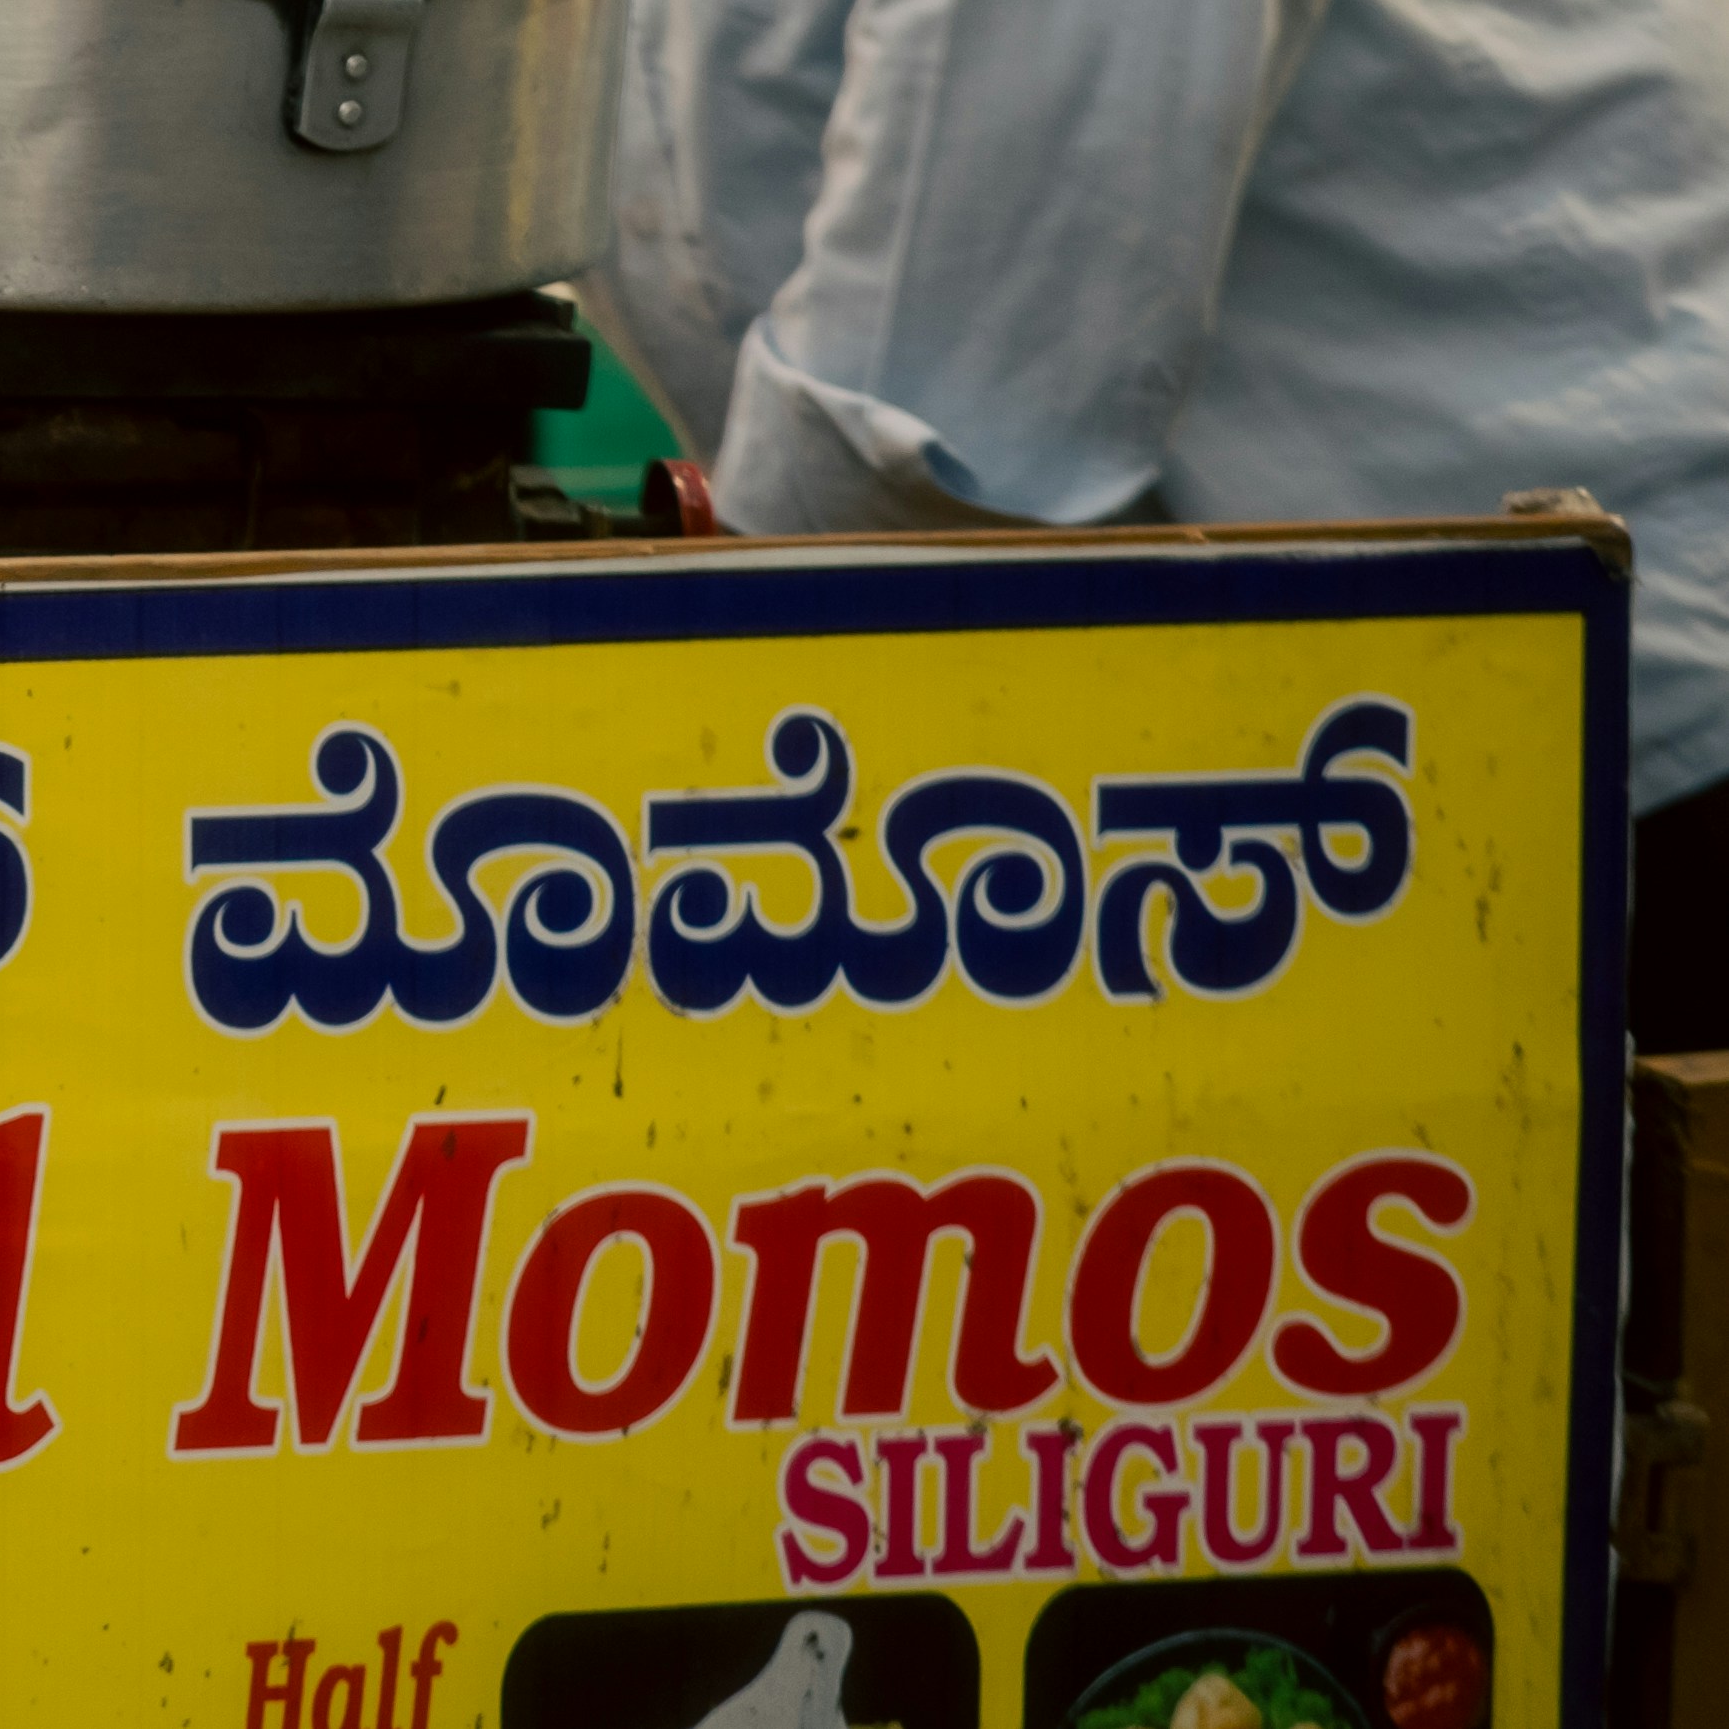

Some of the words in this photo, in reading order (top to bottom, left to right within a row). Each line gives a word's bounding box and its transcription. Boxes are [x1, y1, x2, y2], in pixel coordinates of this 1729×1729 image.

[173, 1119, 1471, 1453] Momos
[782, 1413, 1461, 1585] SILIGURI
[245, 1621, 459, 1729] Half
